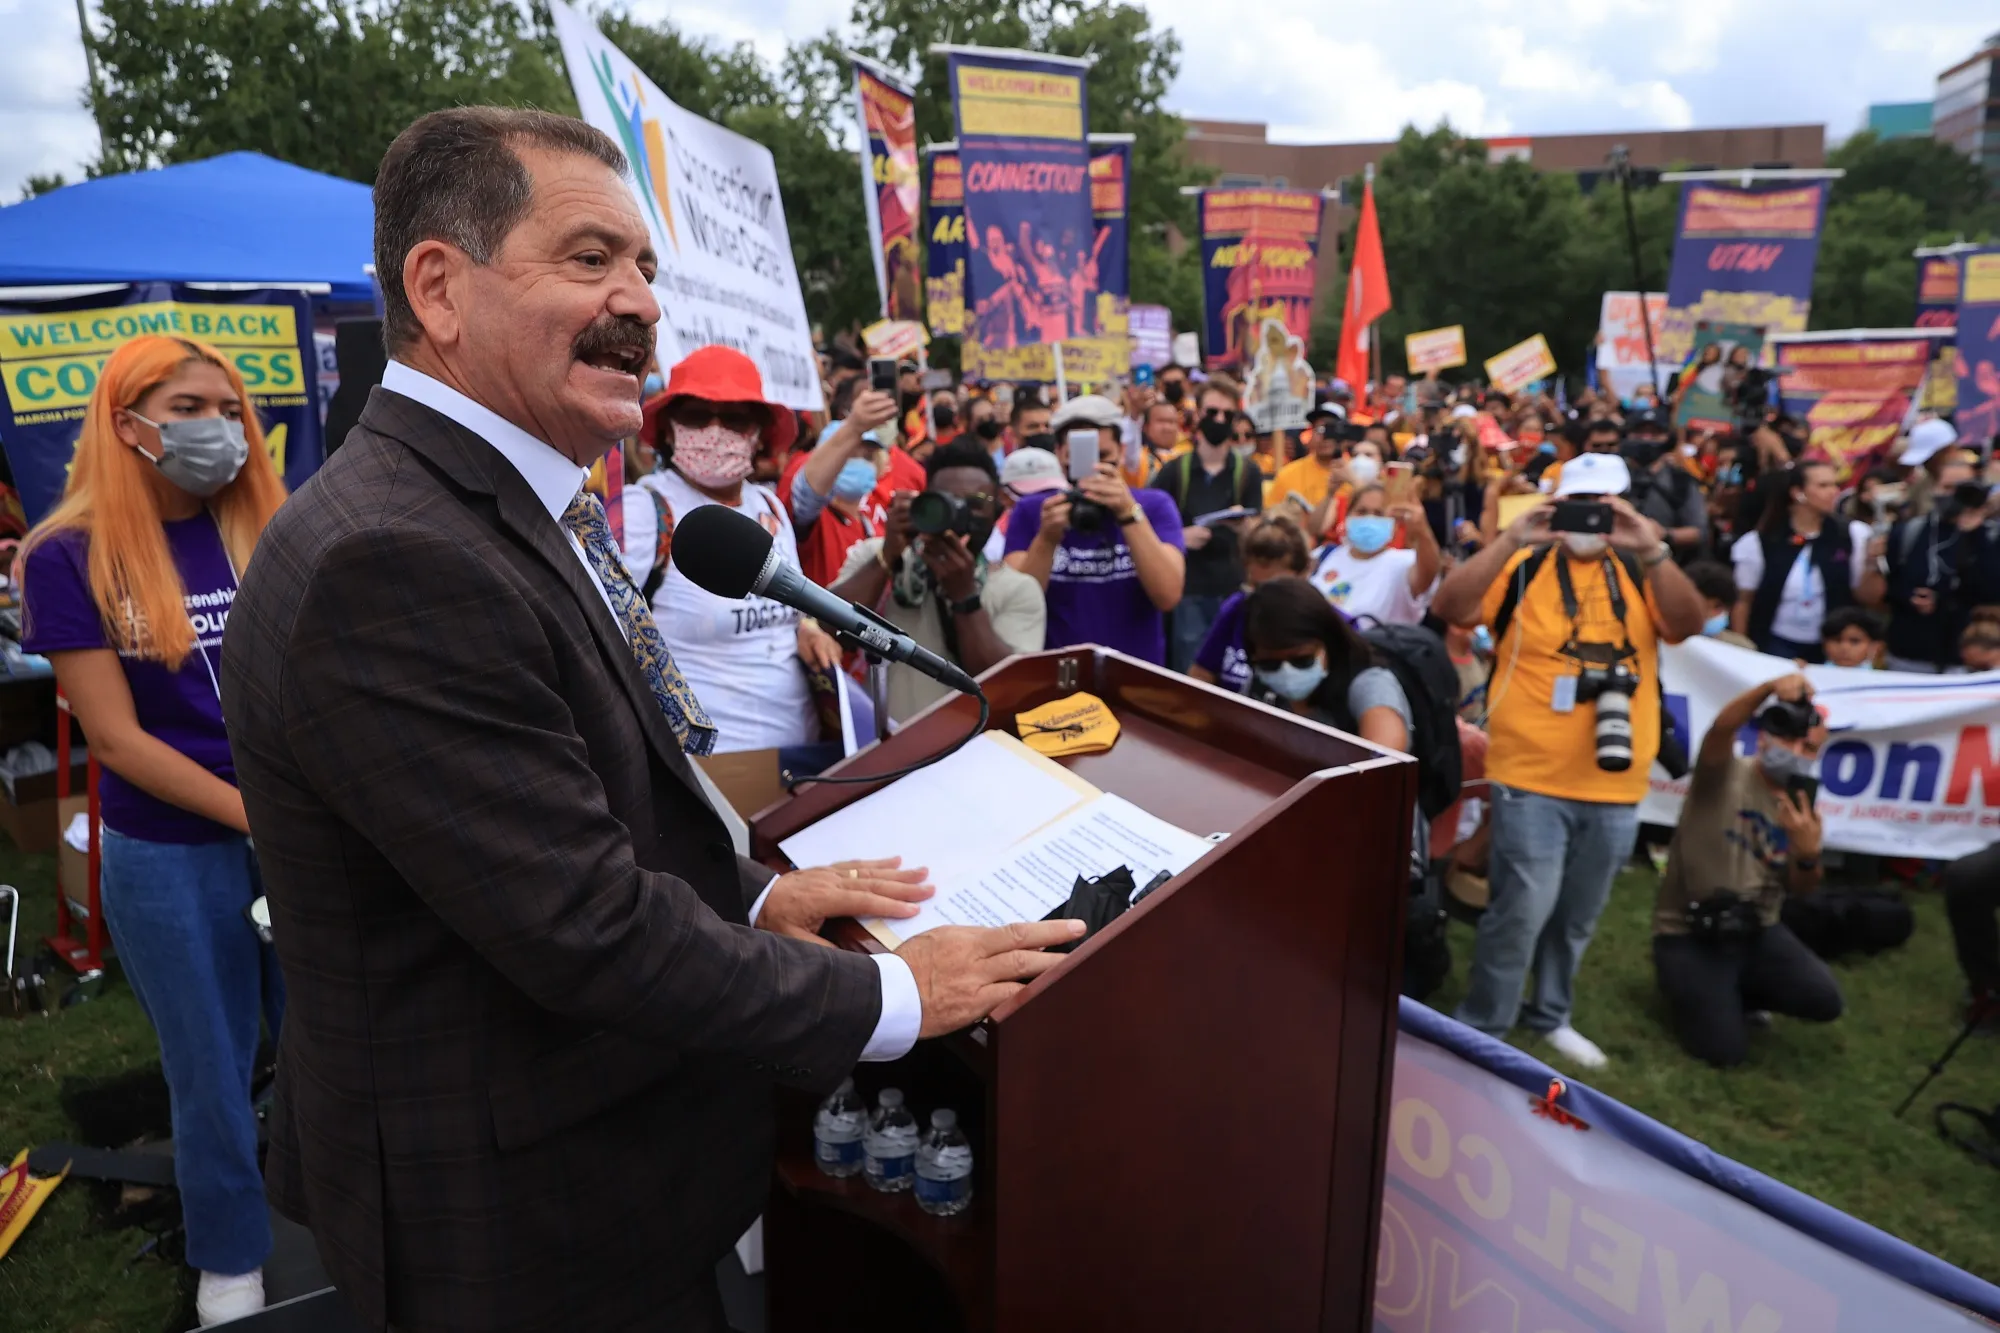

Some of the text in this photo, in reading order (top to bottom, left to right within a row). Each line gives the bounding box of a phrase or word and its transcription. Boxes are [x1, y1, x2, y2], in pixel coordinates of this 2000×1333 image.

[967, 160, 1087, 194] CONNECTICUT
[10, 310, 280, 348] WELCOME BACK
